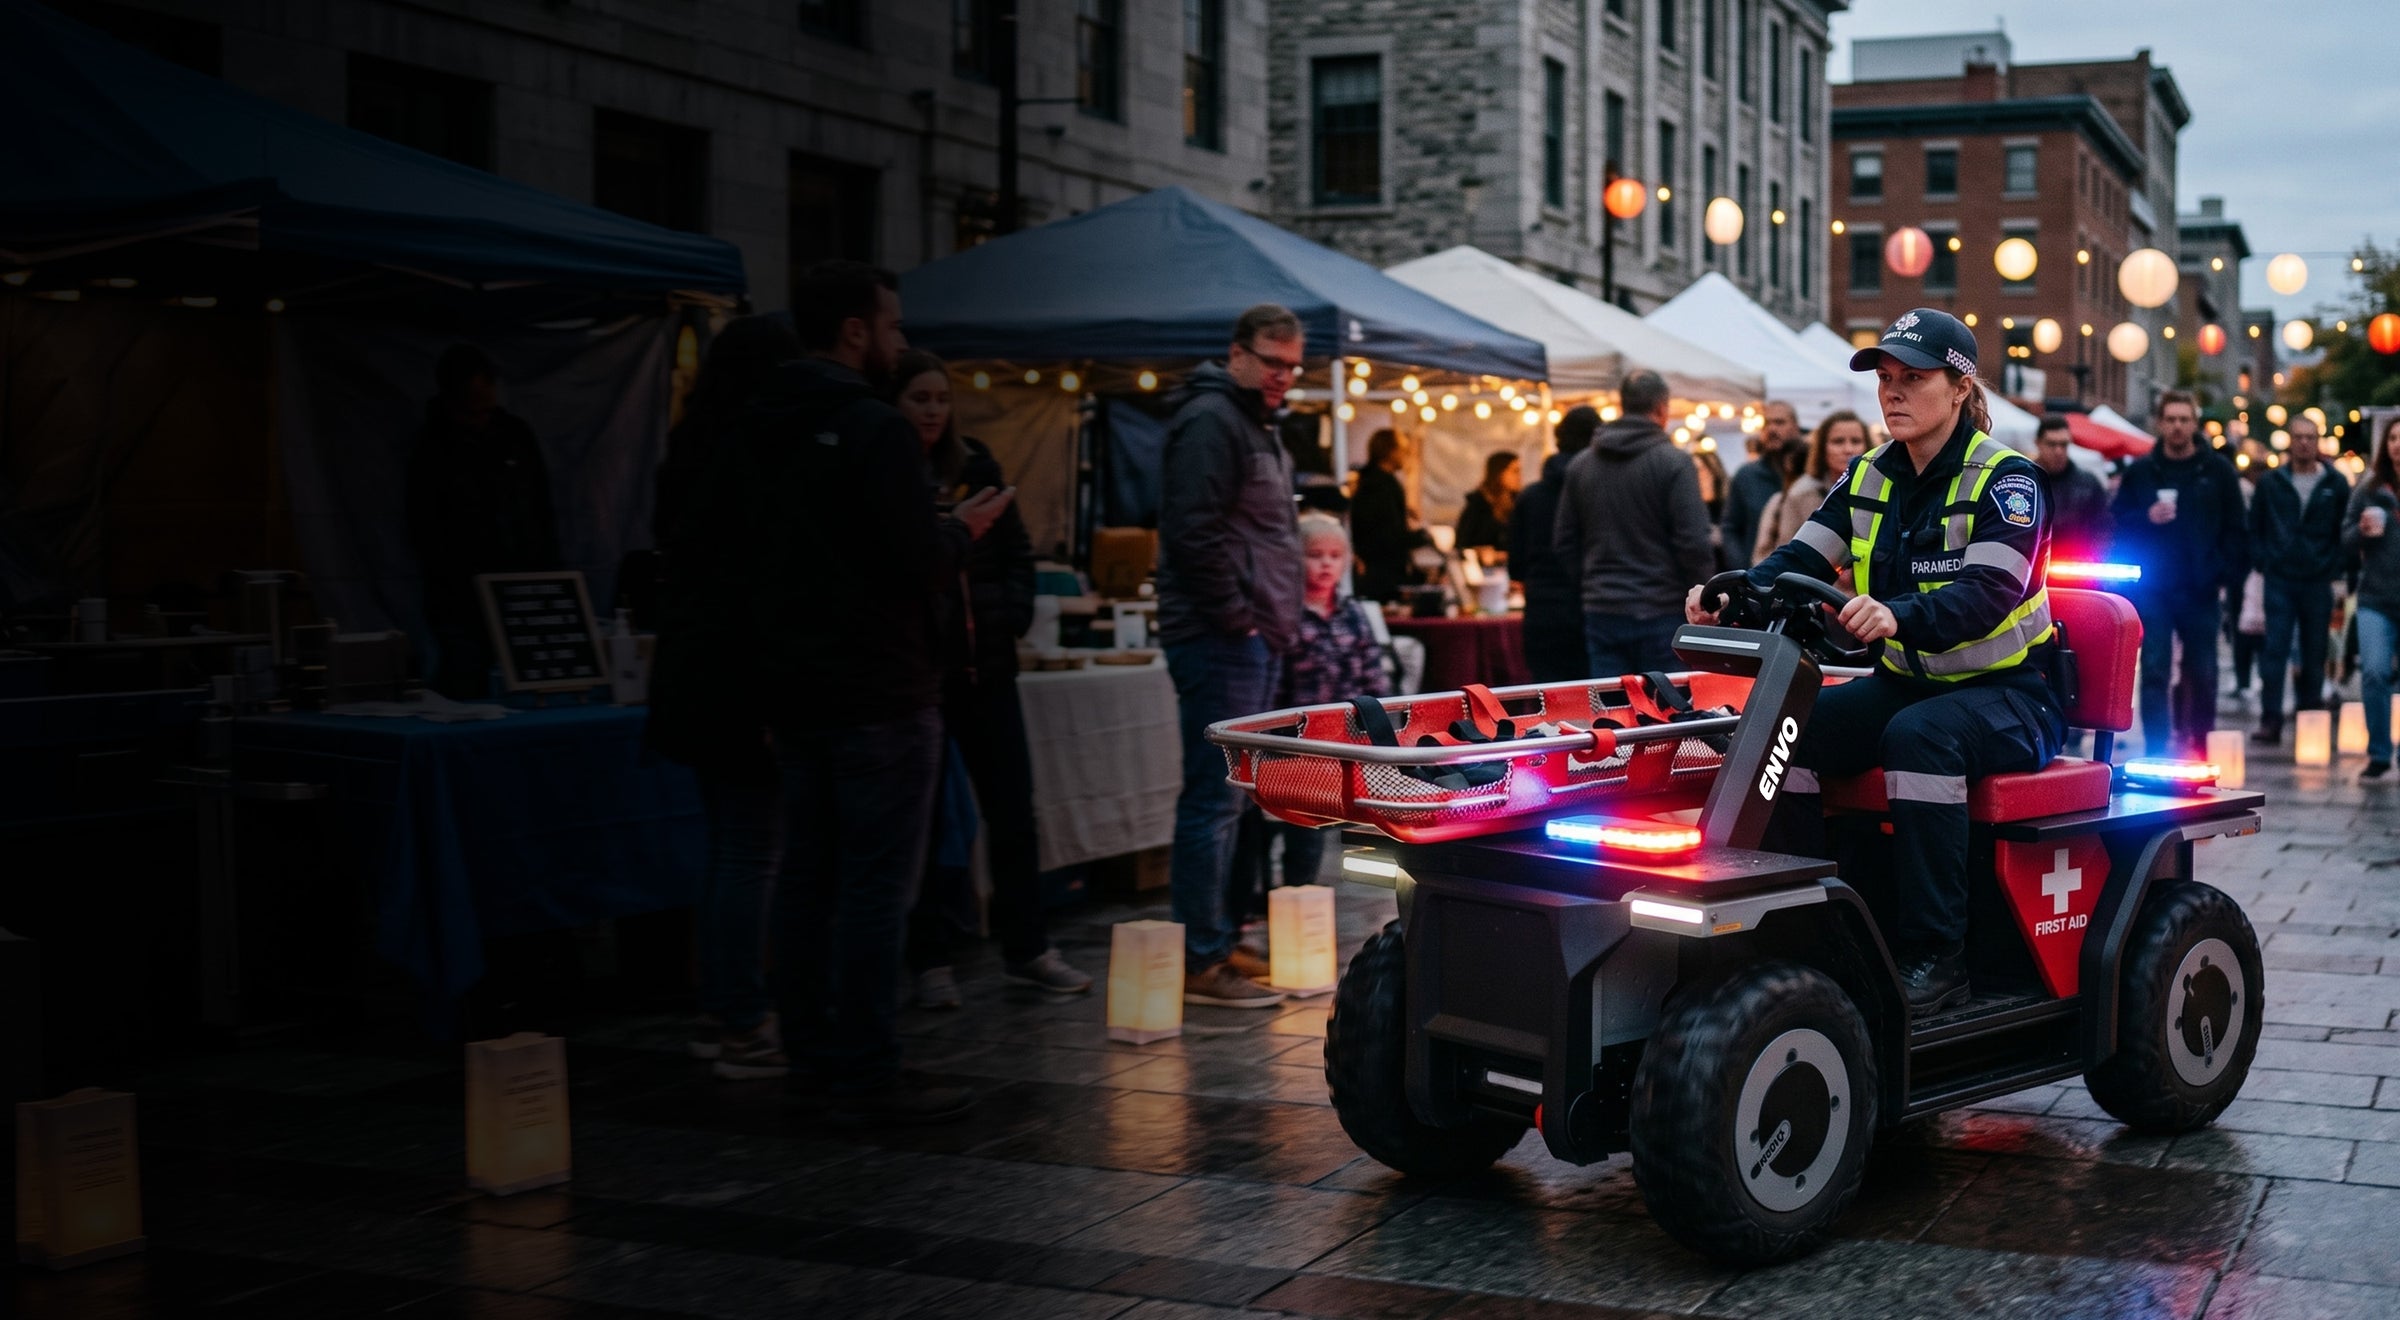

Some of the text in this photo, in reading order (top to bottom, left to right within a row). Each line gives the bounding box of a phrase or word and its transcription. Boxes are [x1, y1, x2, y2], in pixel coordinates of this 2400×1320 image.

[1759, 716, 1798, 801] ENVO
[2035, 914, 2088, 936] FIRST AID
